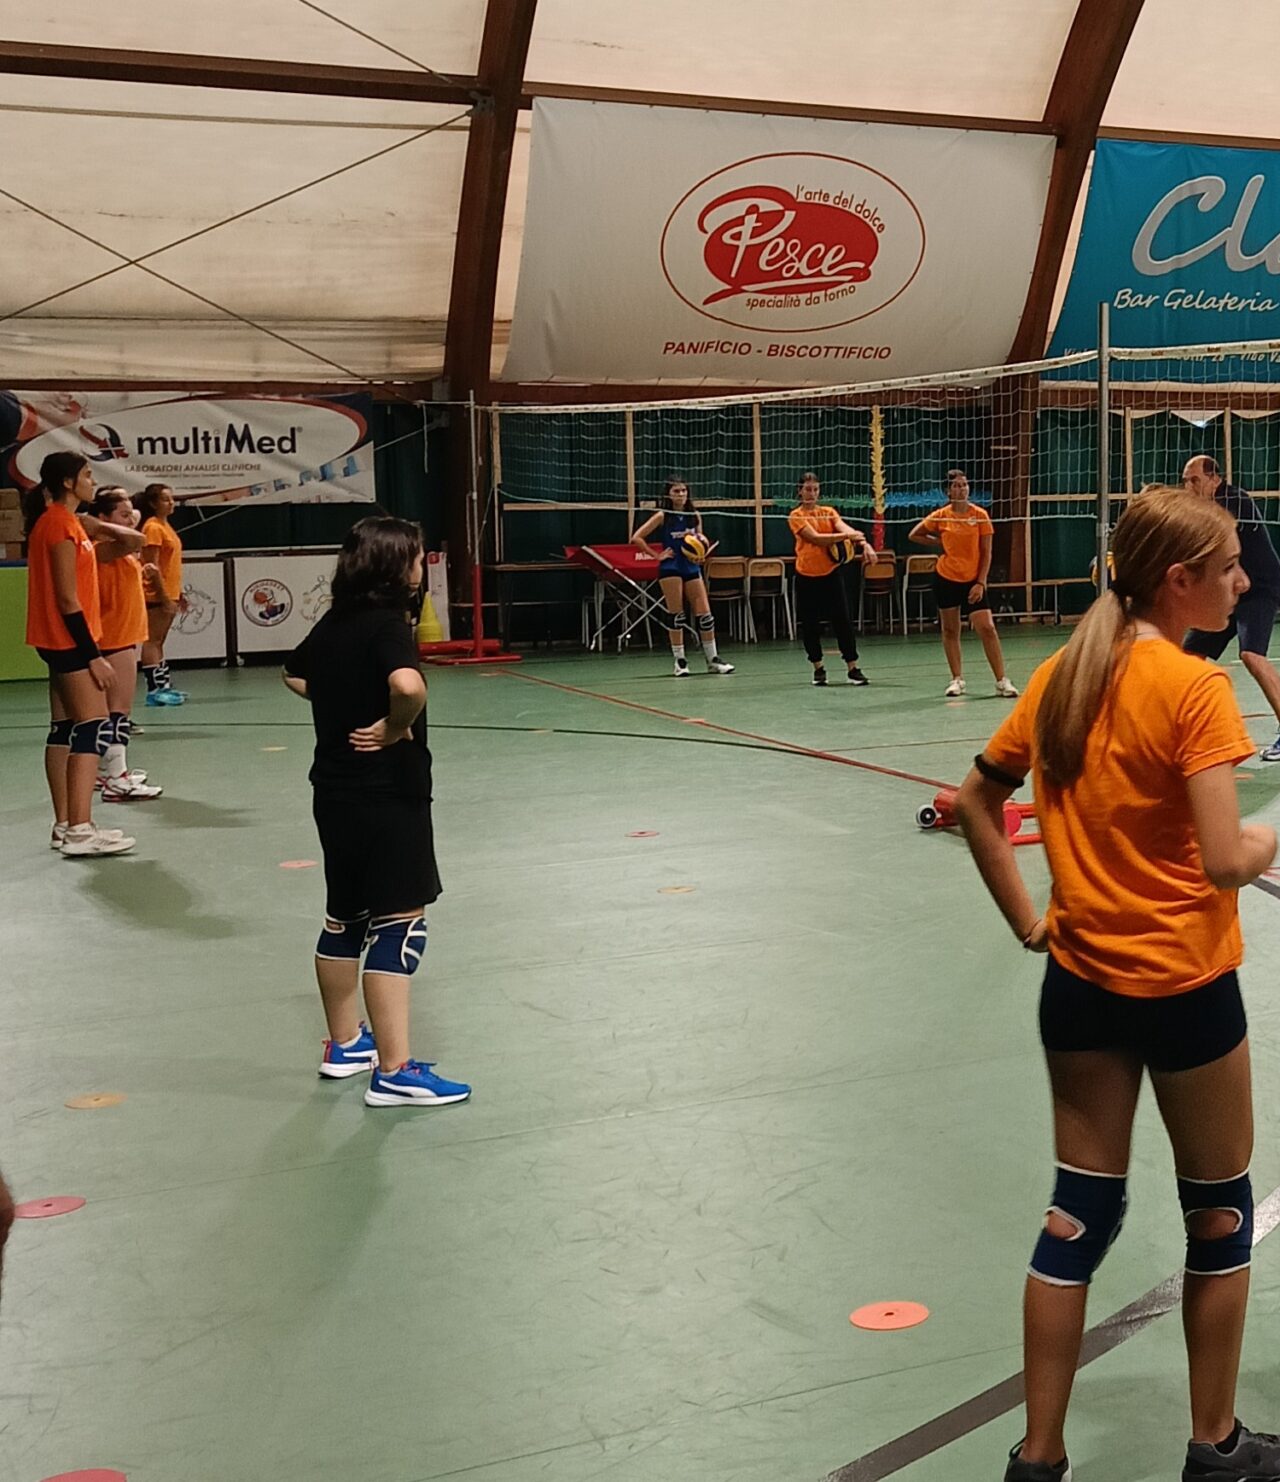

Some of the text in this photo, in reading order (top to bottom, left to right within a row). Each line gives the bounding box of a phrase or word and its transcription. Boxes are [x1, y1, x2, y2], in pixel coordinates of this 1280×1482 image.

[796, 184, 885, 233] l'arte del dolce
[710, 200, 865, 278] Pesce
[805, 292, 820, 306] da
[824, 285, 856, 302] torno
[1114, 289, 1159, 309] Bar
[1163, 289, 1280, 312] Gelateria
[663, 340, 751, 355] PANIFICIO
[767, 343, 891, 360] BISCOTTIFICIO
